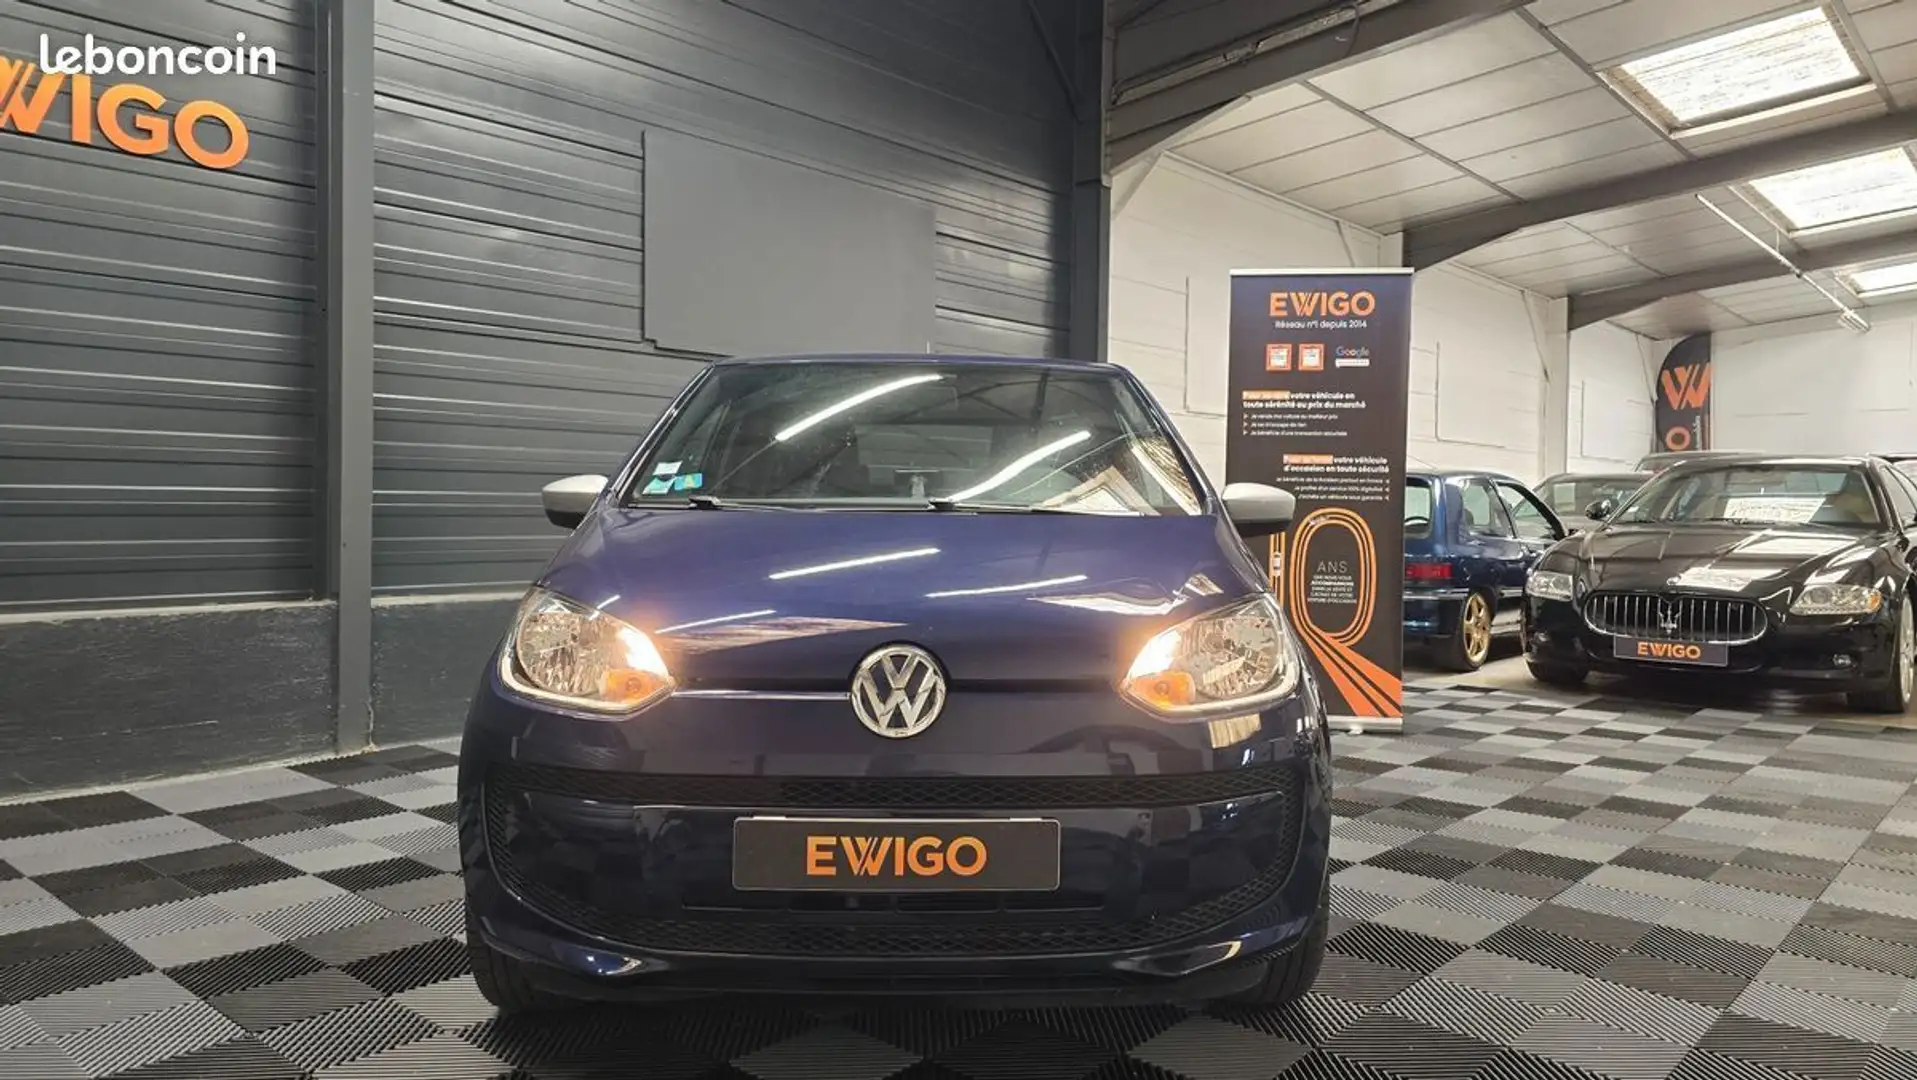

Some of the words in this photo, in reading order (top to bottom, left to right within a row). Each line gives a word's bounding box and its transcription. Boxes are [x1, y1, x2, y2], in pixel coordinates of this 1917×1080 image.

[1270, 290, 1375, 316] EWIGO
[1320, 320, 1347, 331] depuis
[1348, 320, 1367, 329] 2014
[1336, 346, 1370, 358] Google
[1316, 560, 1348, 574] ANS
[1637, 641, 1701, 659] EWIGO
[806, 836, 987, 876] EWIGO
